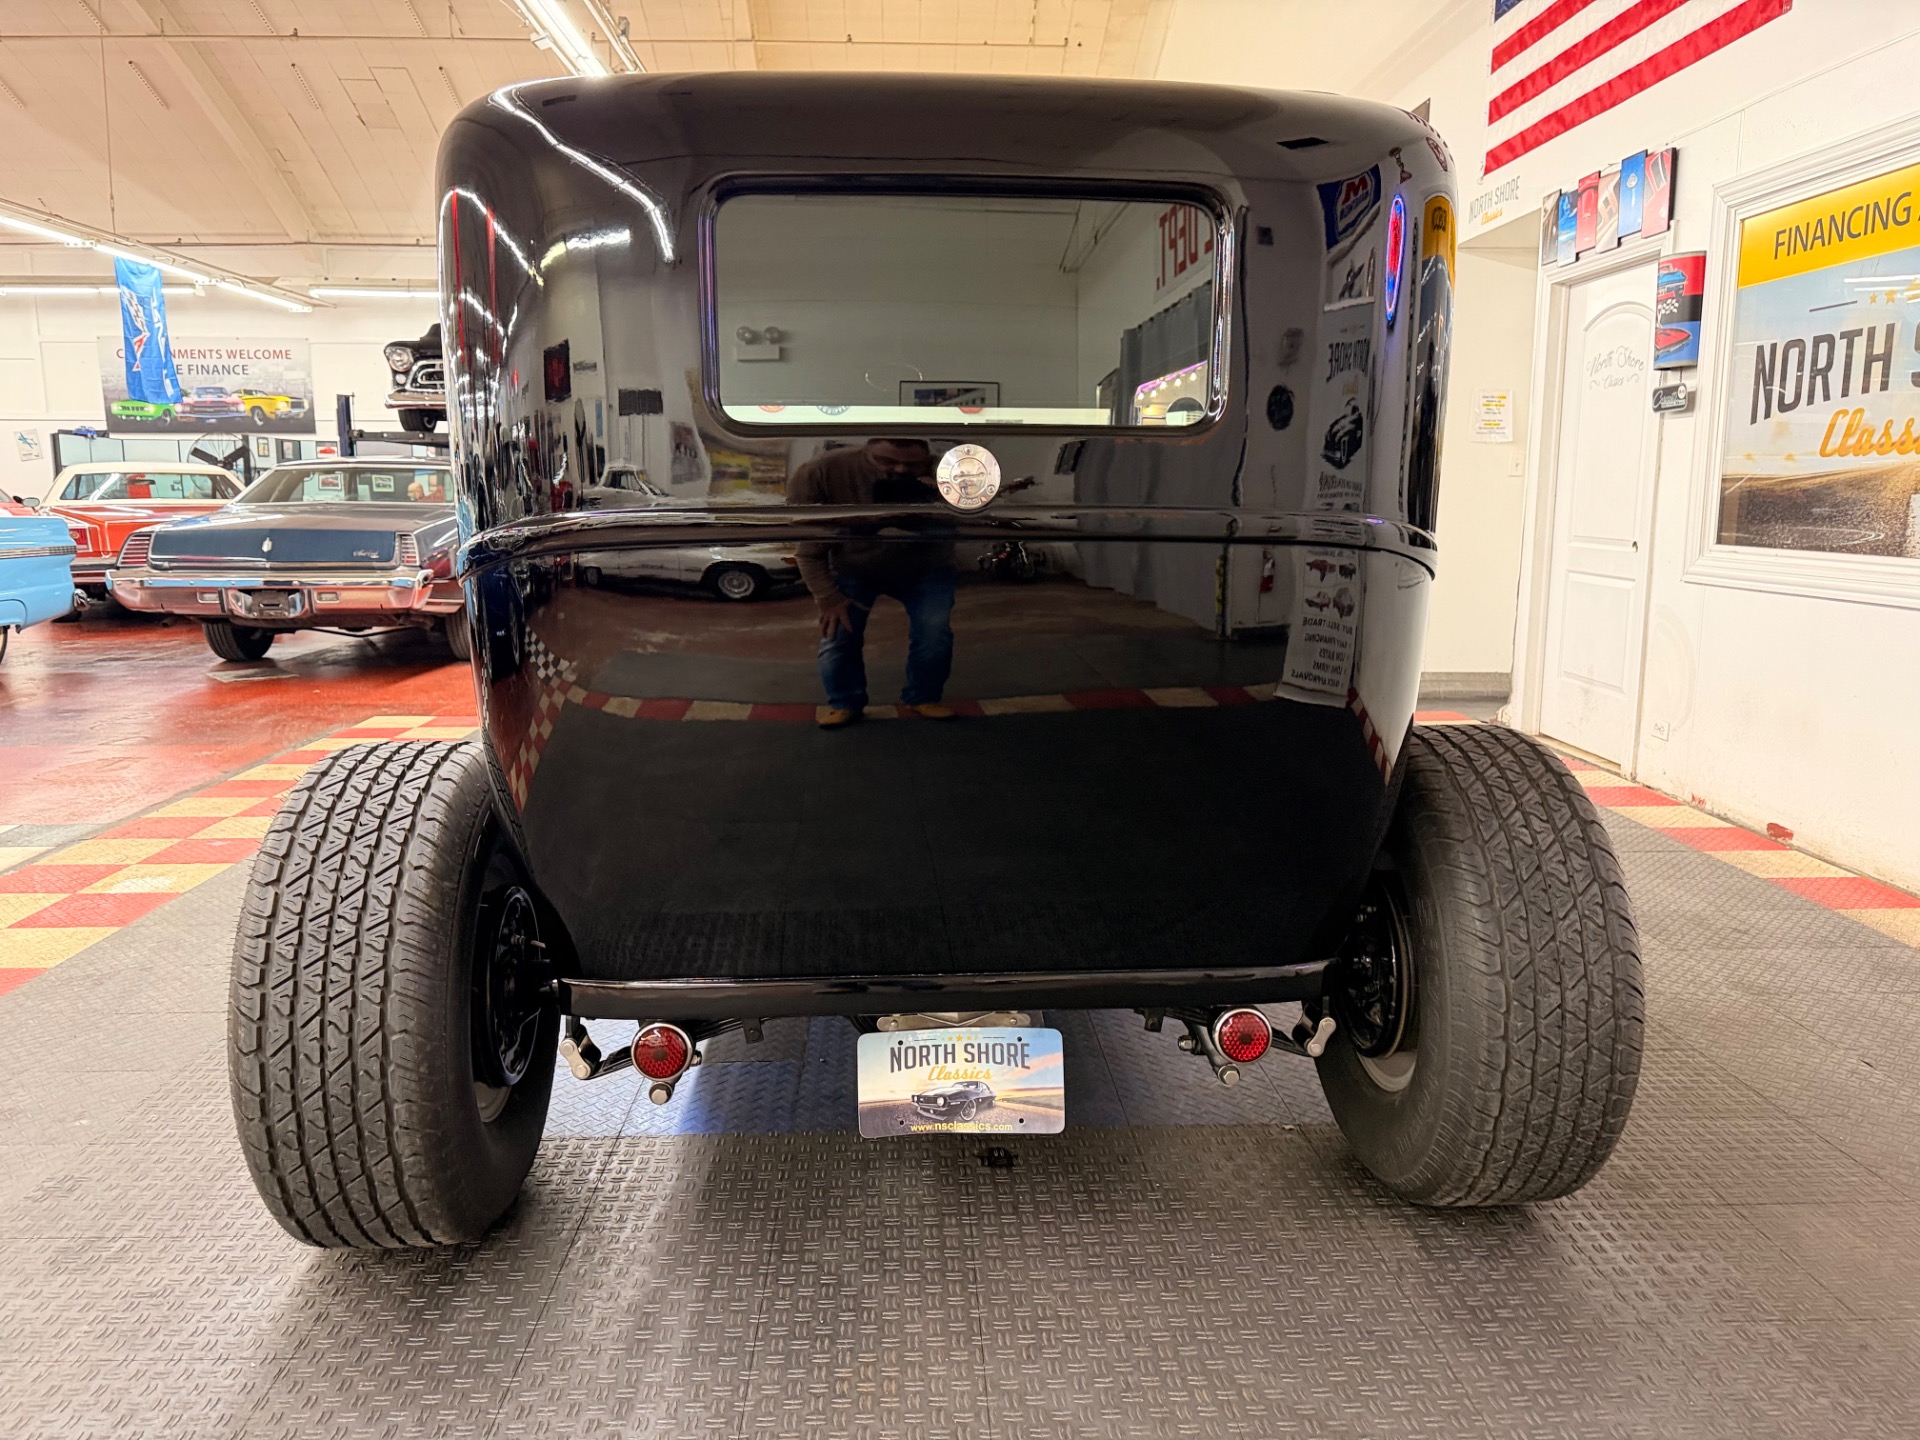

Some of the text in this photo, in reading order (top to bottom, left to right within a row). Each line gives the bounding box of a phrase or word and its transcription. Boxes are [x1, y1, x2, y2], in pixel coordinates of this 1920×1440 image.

[1469, 190, 1493, 224] NORTH
[1495, 175, 1520, 205] SHORE
[1773, 191, 1912, 260] FINANCING
[116, 348, 292, 360] CNMENTS WELCOME
[187, 364, 249, 376] FINANCE
[1750, 322, 1896, 425] NORTH
[1819, 407, 1920, 458] Class
[889, 1042, 1031, 1073] NORTH SHORE
[927, 1065, 992, 1081] Classics
[910, 1120, 1013, 1132] www.nsclassics.com
